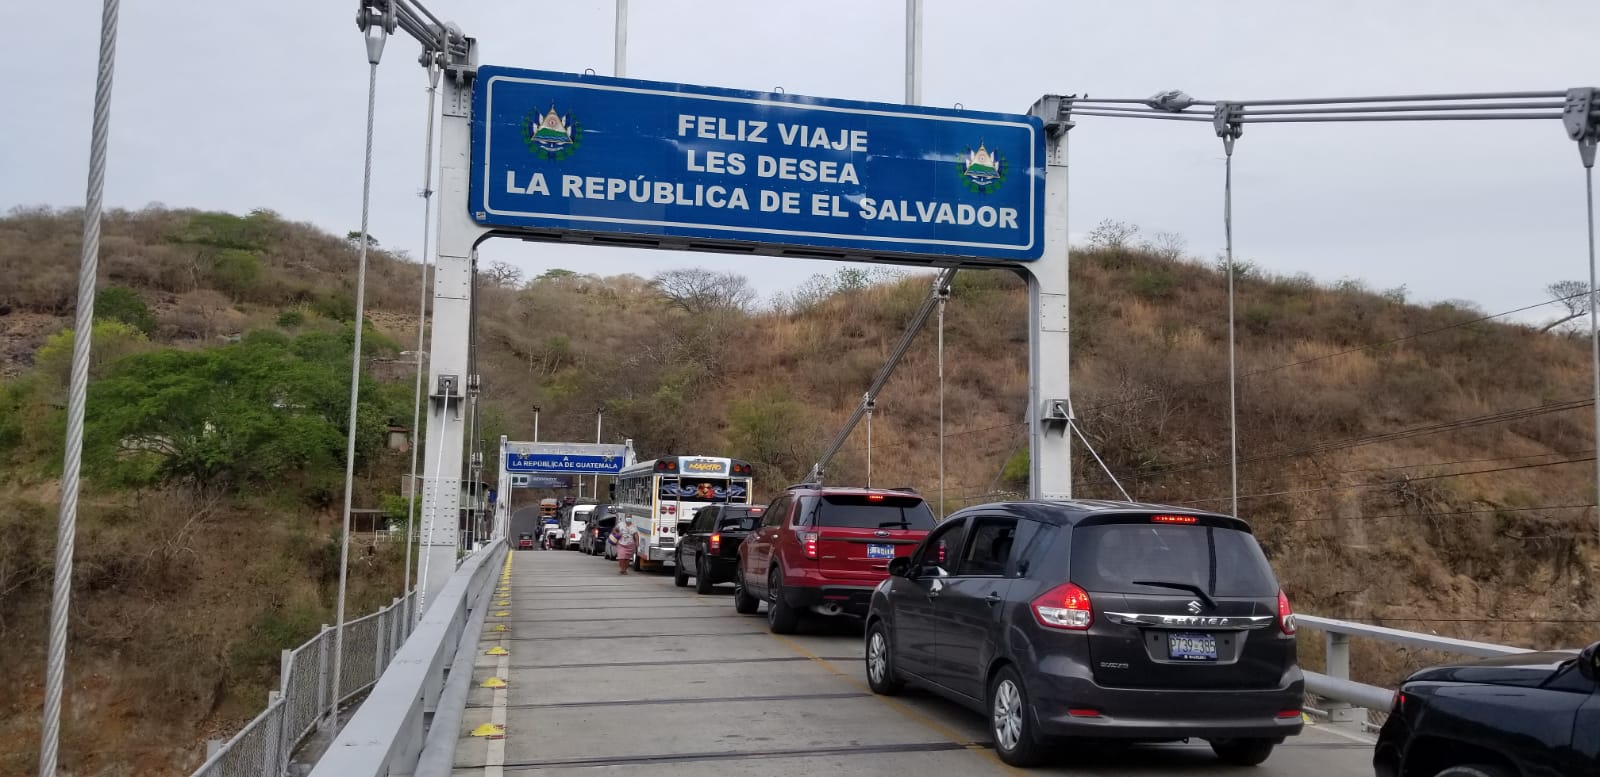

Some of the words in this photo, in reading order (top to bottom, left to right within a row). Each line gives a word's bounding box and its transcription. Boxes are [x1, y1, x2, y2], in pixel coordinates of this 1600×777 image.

[678, 114, 768, 143] FELIZ
[777, 124, 868, 153] VIAJE
[686, 149, 746, 175] LES
[757, 155, 860, 185] DESEA
[506, 171, 550, 196] LA
[562, 174, 749, 211] REPÚBLICA
[760, 190, 801, 214] DE
[811, 194, 849, 218] EL
[859, 197, 1018, 230] SALVADOR
[523, 460, 564, 469] REPÚBLICA
[564, 461, 575, 469] DE
[575, 462, 618, 470] GUATEMALA
